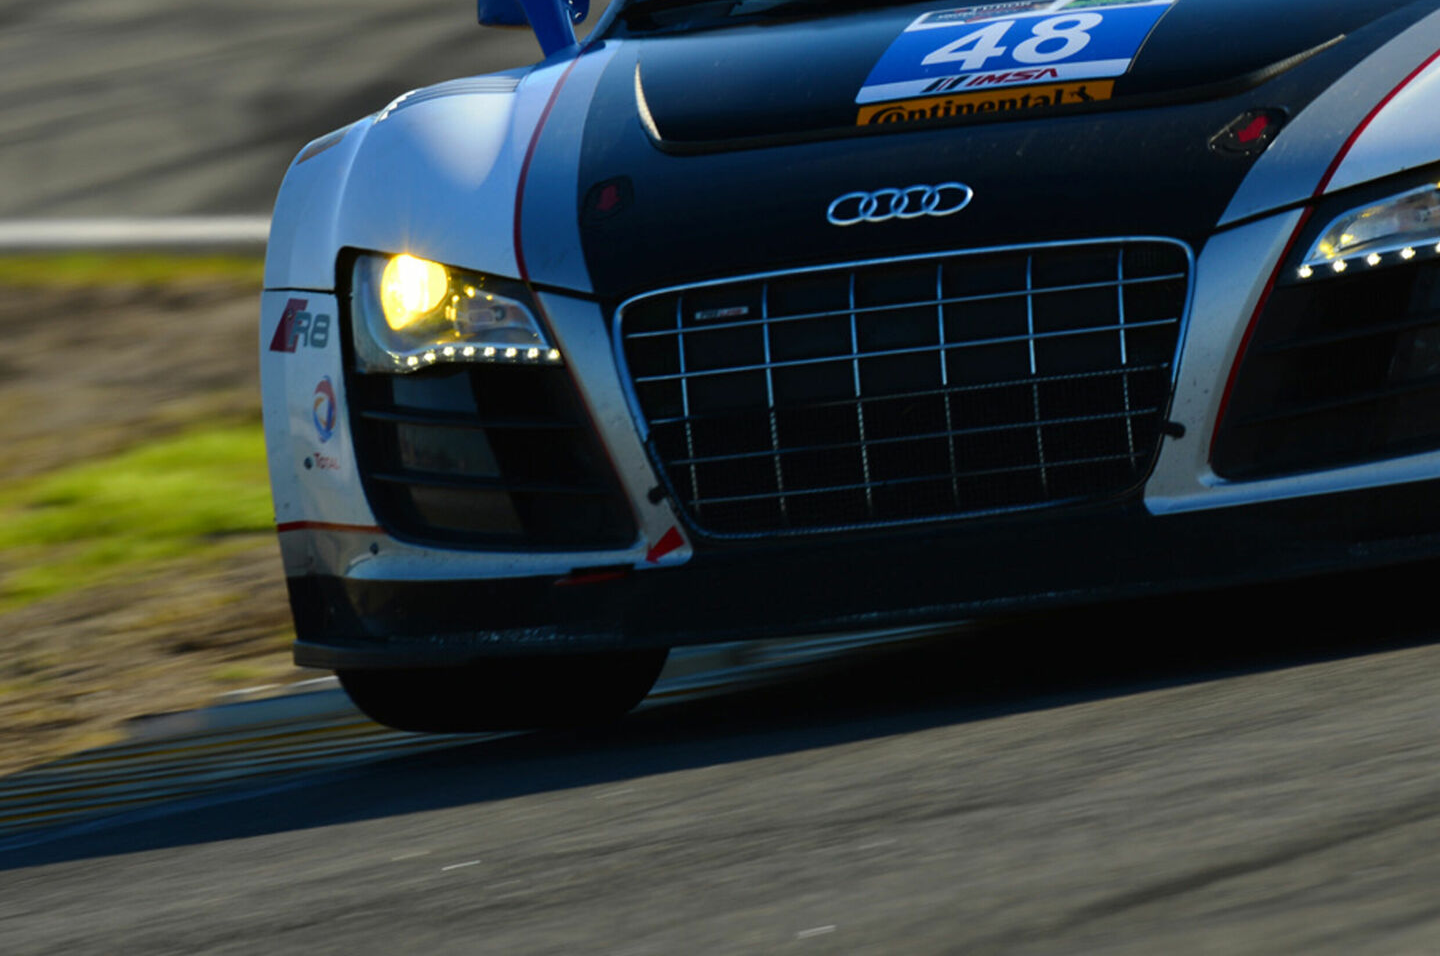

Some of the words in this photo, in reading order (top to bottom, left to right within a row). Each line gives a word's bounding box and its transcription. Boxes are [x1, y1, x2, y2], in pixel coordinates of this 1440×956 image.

[920, 12, 1103, 71] 48
[963, 68, 1058, 87] IMSA
[868, 85, 1064, 125] Continental
[288, 312, 331, 349] R8
